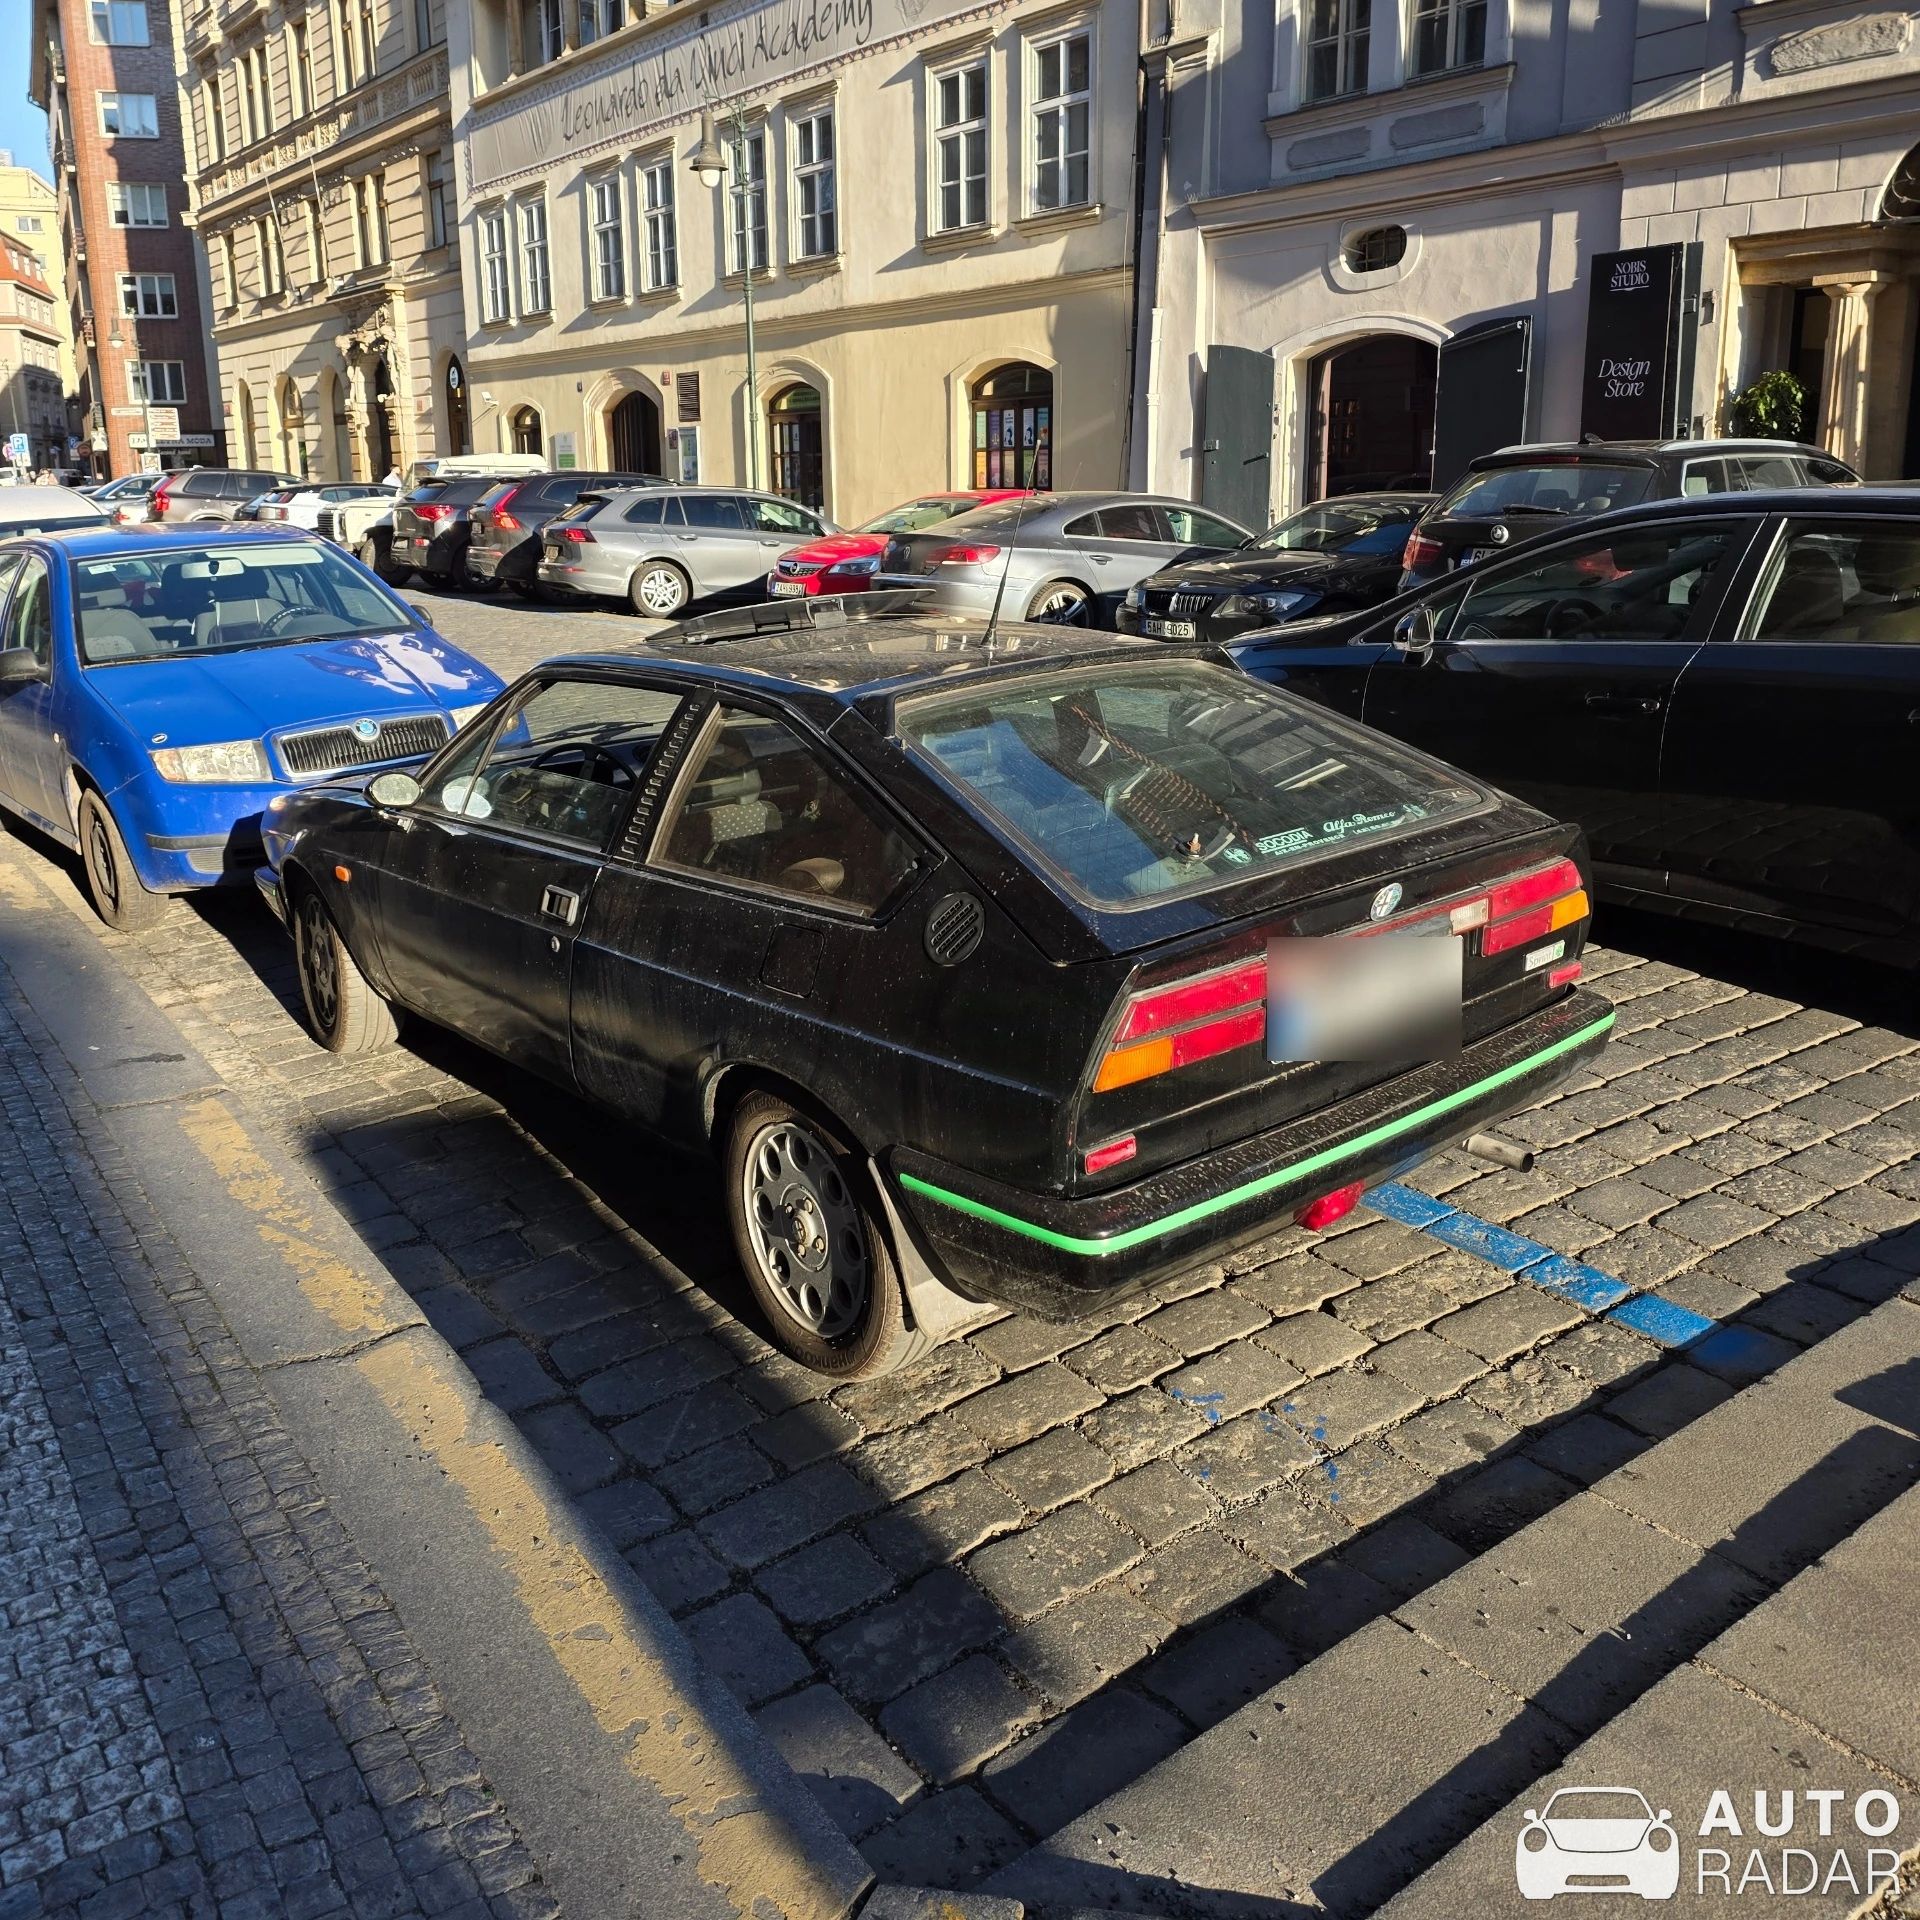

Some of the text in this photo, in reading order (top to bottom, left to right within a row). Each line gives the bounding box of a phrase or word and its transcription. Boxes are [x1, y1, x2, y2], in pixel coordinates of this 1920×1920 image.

[561, 59, 649, 141] Leonardo
[655, 48, 685, 107] da
[752, 0, 873, 70] Academy
[1614, 260, 1647, 276] NOBIS
[1610, 272, 1650, 288] STUDIO
[1598, 357, 1651, 381] Design
[1604, 378, 1645, 398] Store
[1147, 621, 1189, 636] 5AH 9025
[1323, 818, 1356, 834] Alfa
[1352, 811, 1396, 825] Romeo
[1255, 830, 1314, 851] SOCODIA
[1529, 950, 1552, 968] Sprint
